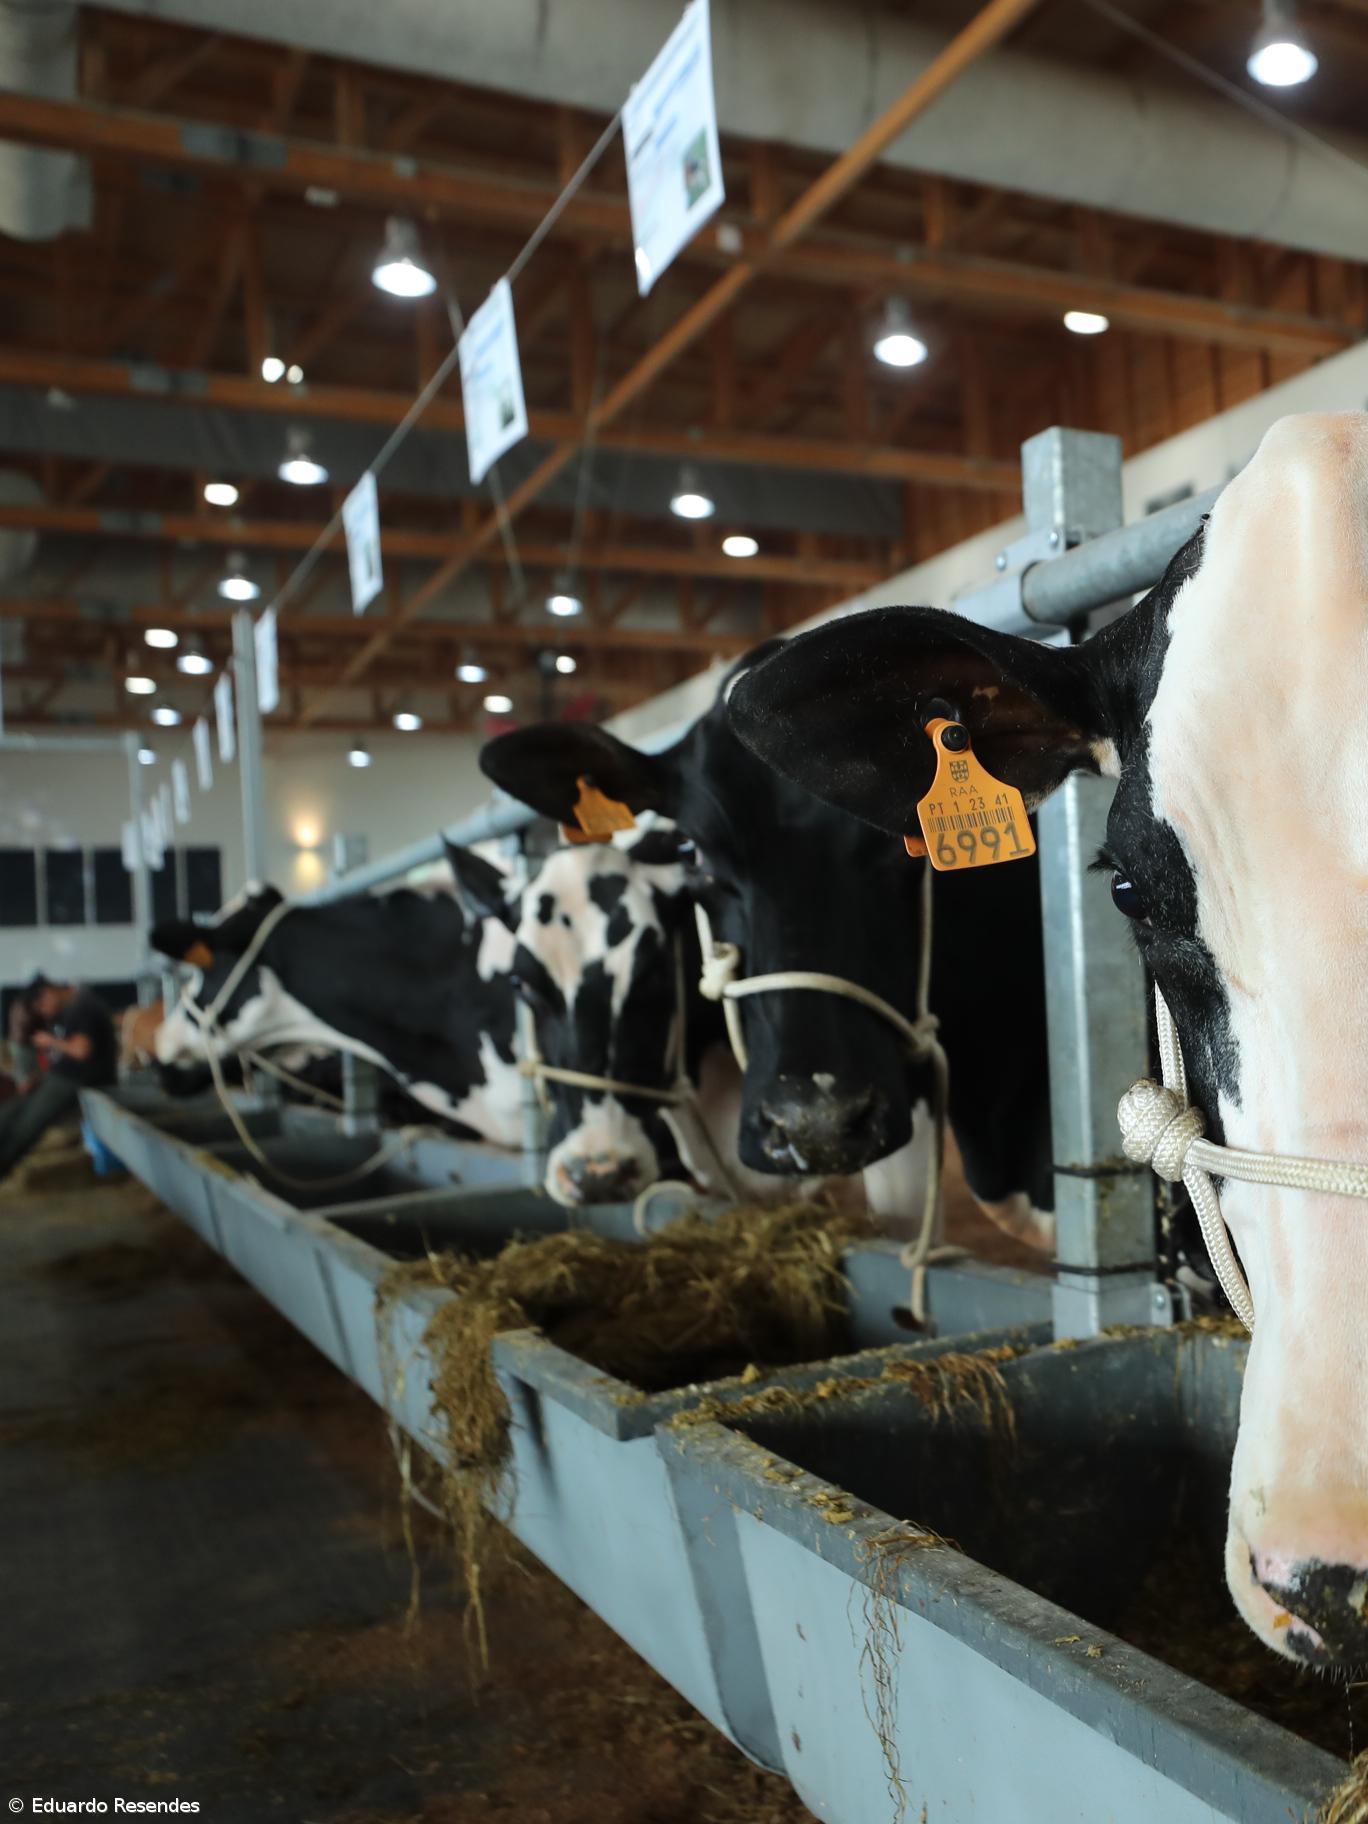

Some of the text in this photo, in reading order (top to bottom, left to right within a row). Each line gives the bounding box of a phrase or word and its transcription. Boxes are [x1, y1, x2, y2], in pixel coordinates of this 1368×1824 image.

[949, 785, 978, 798] RAA
[929, 803, 944, 815] PT
[969, 797, 986, 811] 23
[995, 793, 1009, 806] 41
[936, 821, 1029, 866] 6991
